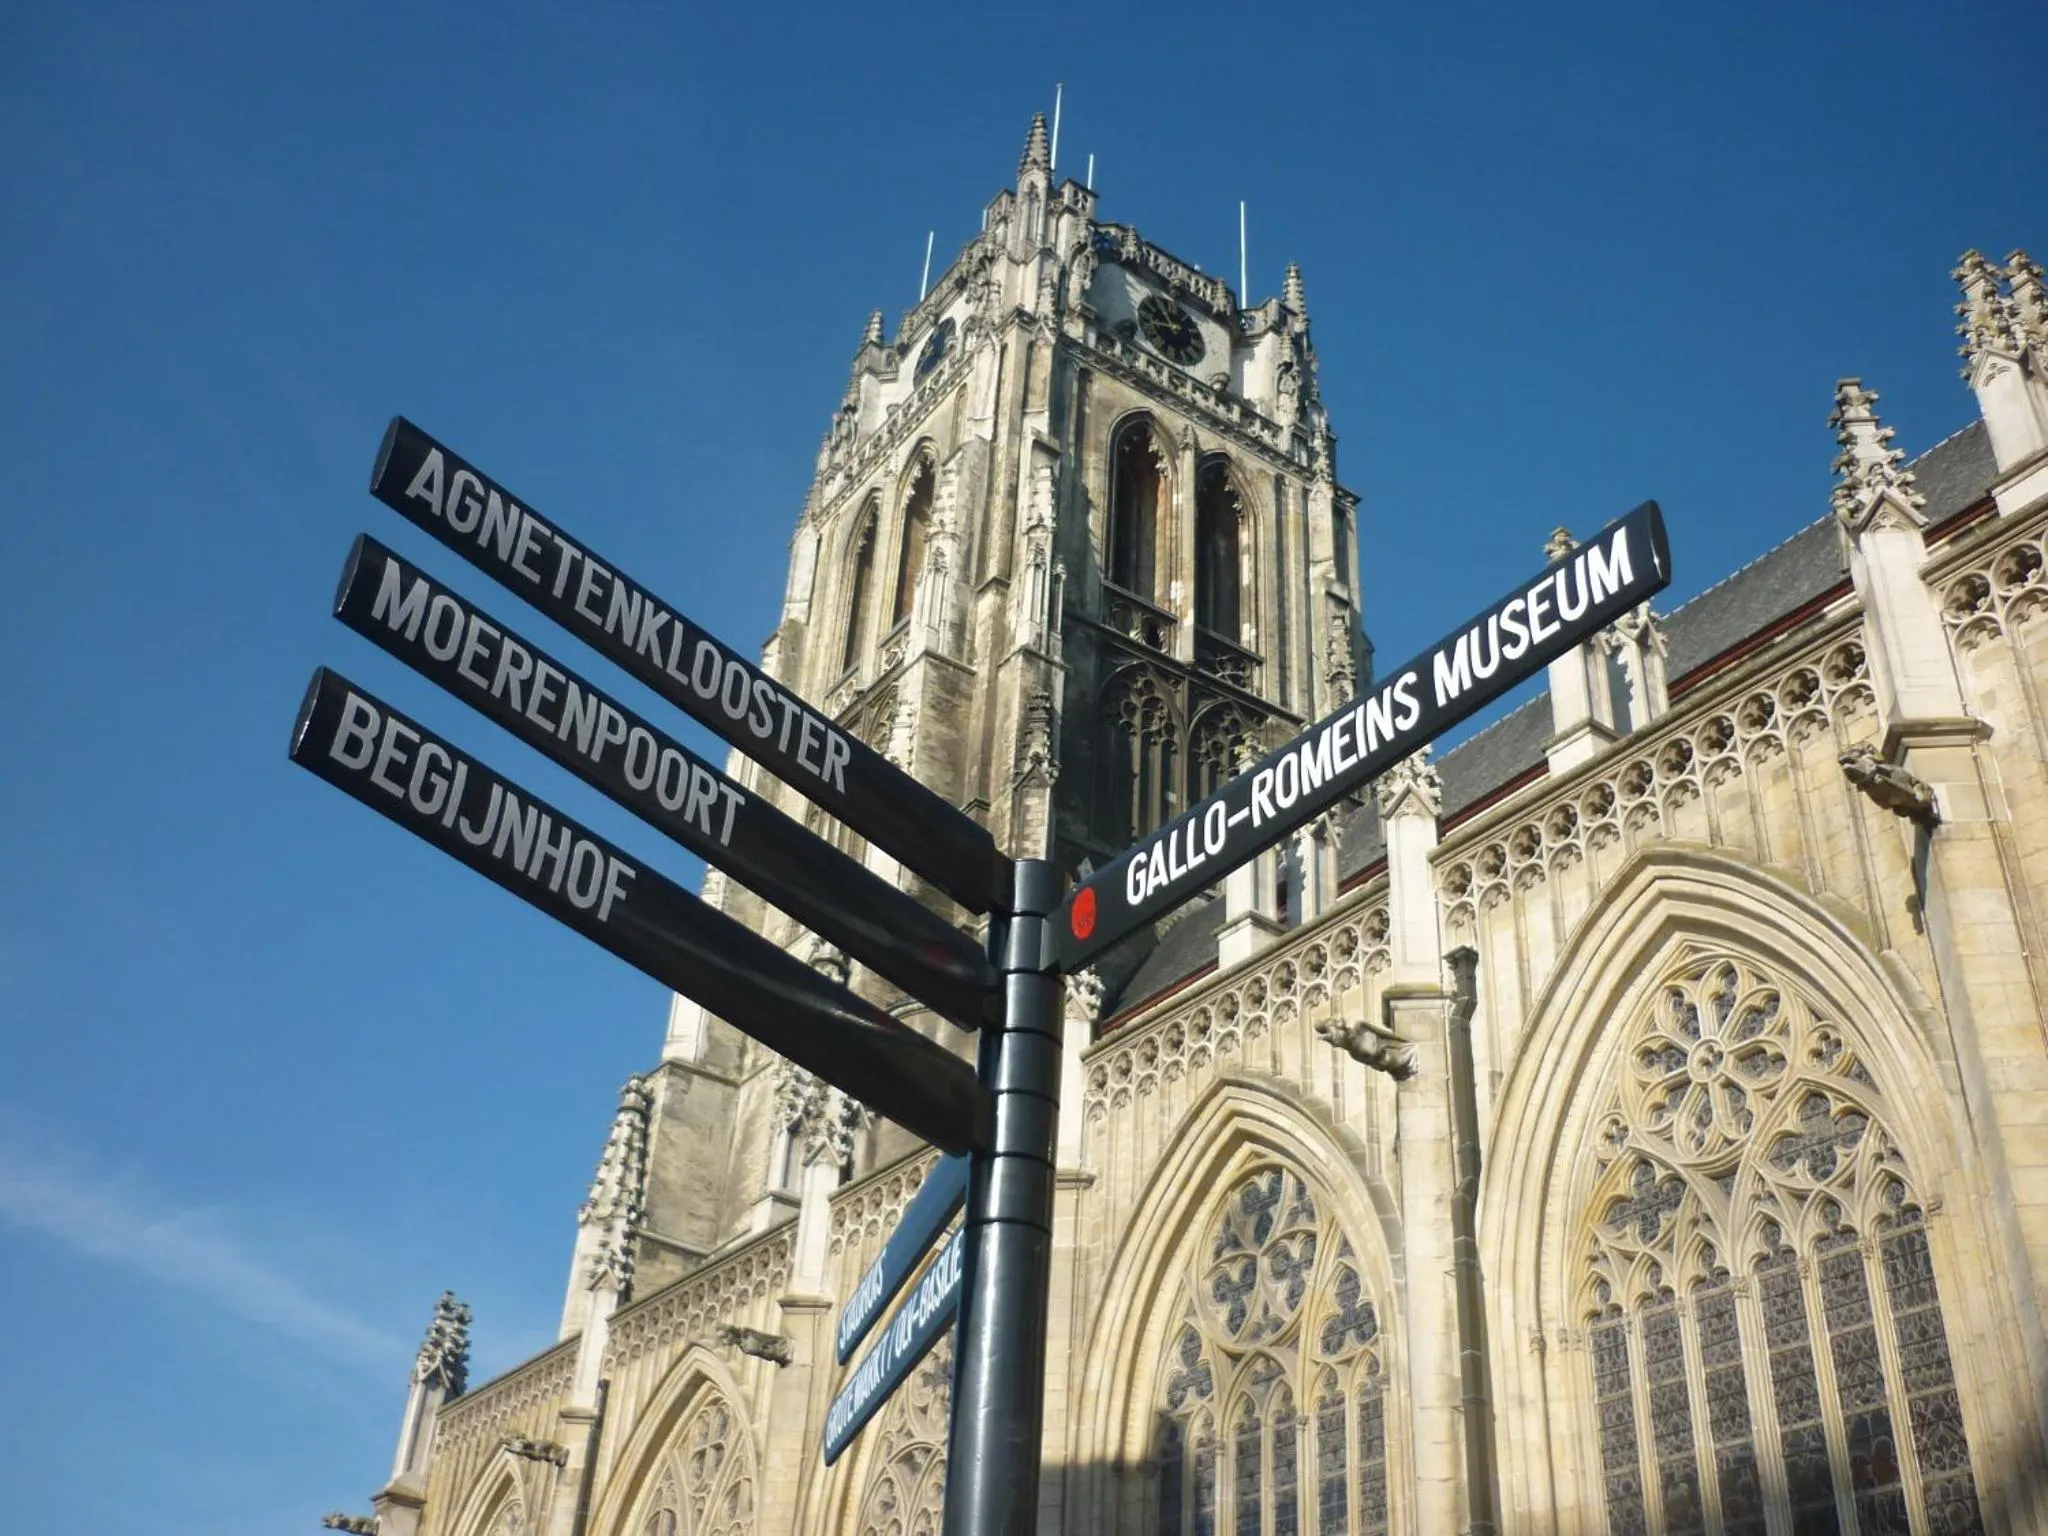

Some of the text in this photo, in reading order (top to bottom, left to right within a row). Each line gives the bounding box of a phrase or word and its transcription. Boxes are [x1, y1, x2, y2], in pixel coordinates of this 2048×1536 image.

[371, 557, 746, 848] MOERENPOORT
[405, 447, 851, 794] AGNETENKLOOSTER
[1126, 527, 1634, 906] GALLO-ROMEINS MUSEUM
[329, 691, 637, 921] BEGIJNHOF
[895, 1229, 965, 1357] OLV-BASILIE
